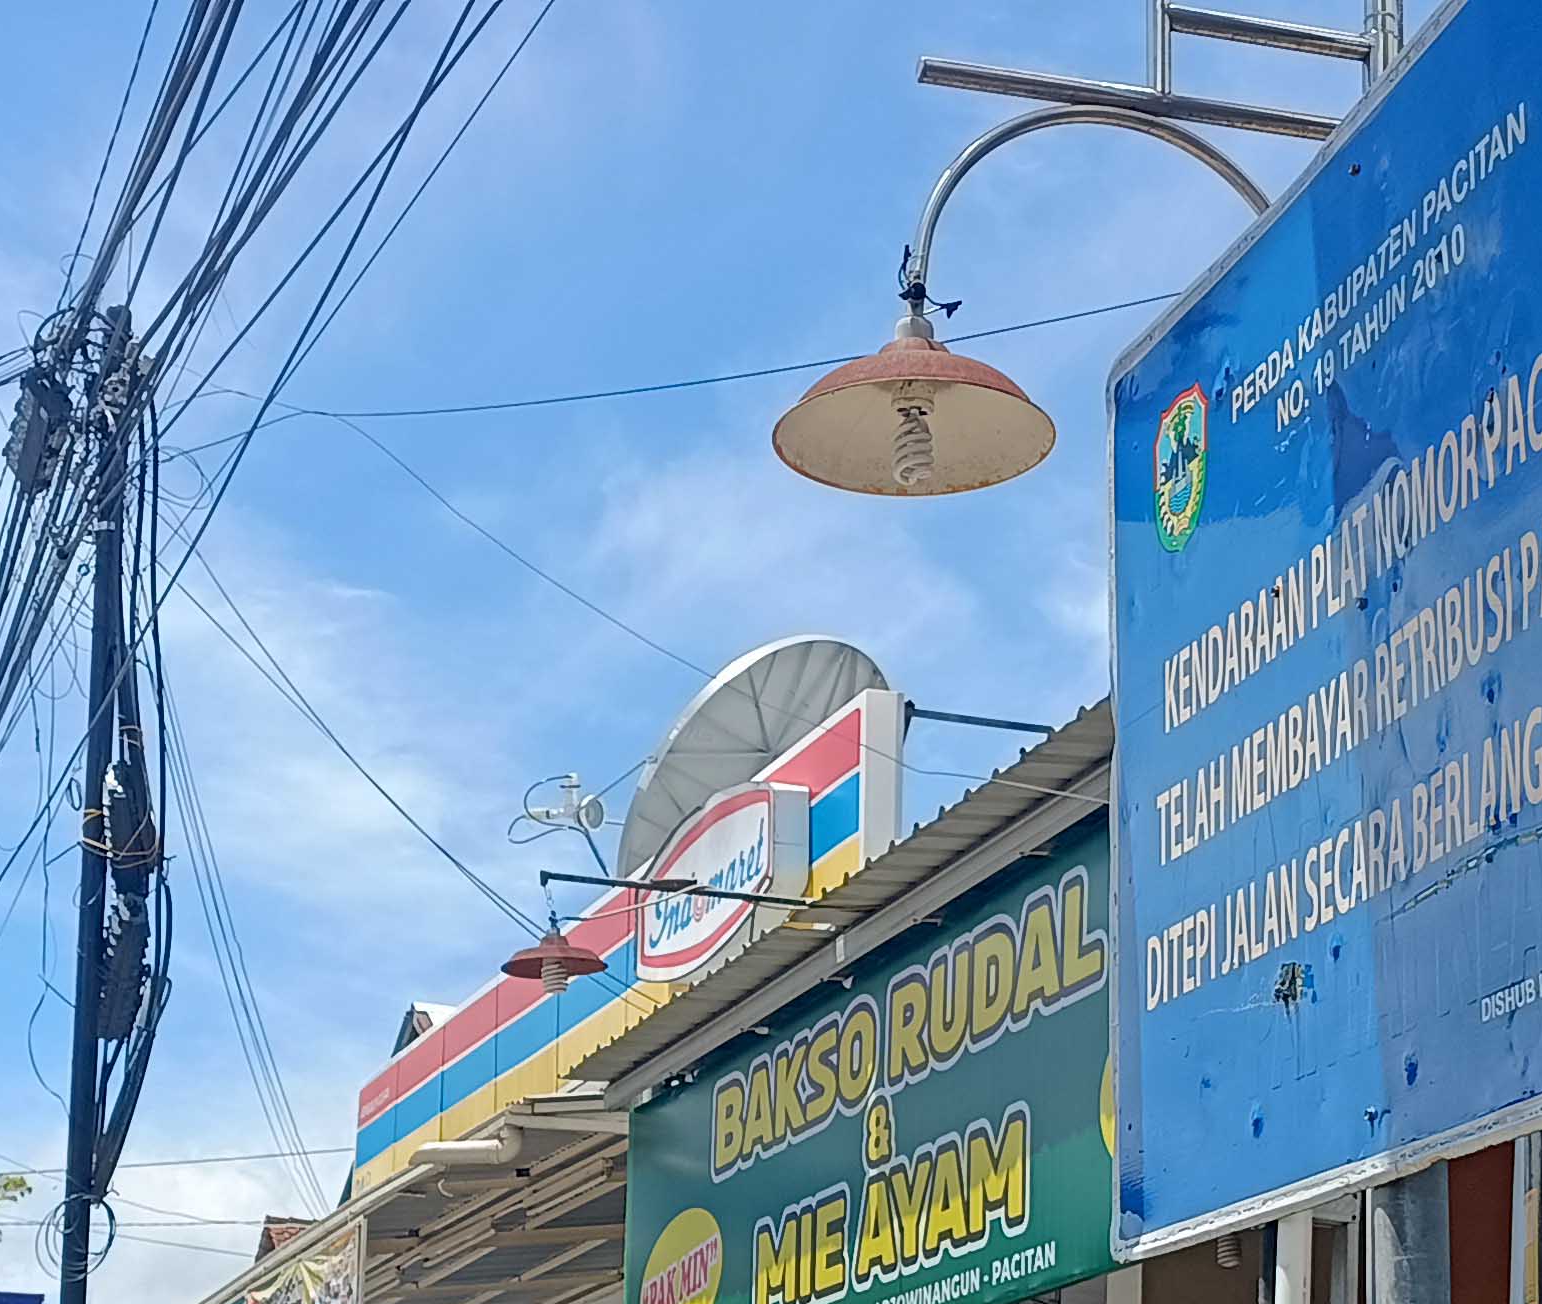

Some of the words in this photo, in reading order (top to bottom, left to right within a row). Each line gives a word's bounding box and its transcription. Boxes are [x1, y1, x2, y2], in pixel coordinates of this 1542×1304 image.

[1231, 353, 1294, 425] PERDA
[1296, 211, 1416, 360] KABUPATEN
[1421, 102, 1528, 239] PACITAN
[1276, 387, 1310, 433] NO.
[1312, 357, 1335, 395] 19
[1339, 287, 1406, 371] TAHUN
[1412, 223, 1465, 304] 2010
[1165, 568, 1305, 734] KENDARAAN
[1311, 506, 1369, 630] PLAT
[1373, 416, 1479, 571] NOMOR
[1157, 753, 1226, 866] TELAH
[1231, 658, 1370, 826] MEMBAYAR
[1375, 546, 1515, 732] RETRIBUSI
[1147, 911, 1217, 1011] DITEPI
[1222, 858, 1299, 978] JALAN
[1303, 799, 1408, 934] SECARA
[1480, 978, 1535, 1024] DISHUB
[712, 1000, 877, 1180] BAKSO
[887, 867, 1105, 1090] RUDAL
[855, 1104, 1029, 1288] AYAM
[863, 1094, 893, 1168] &
[991, 1240, 1056, 1286] PACITAN
